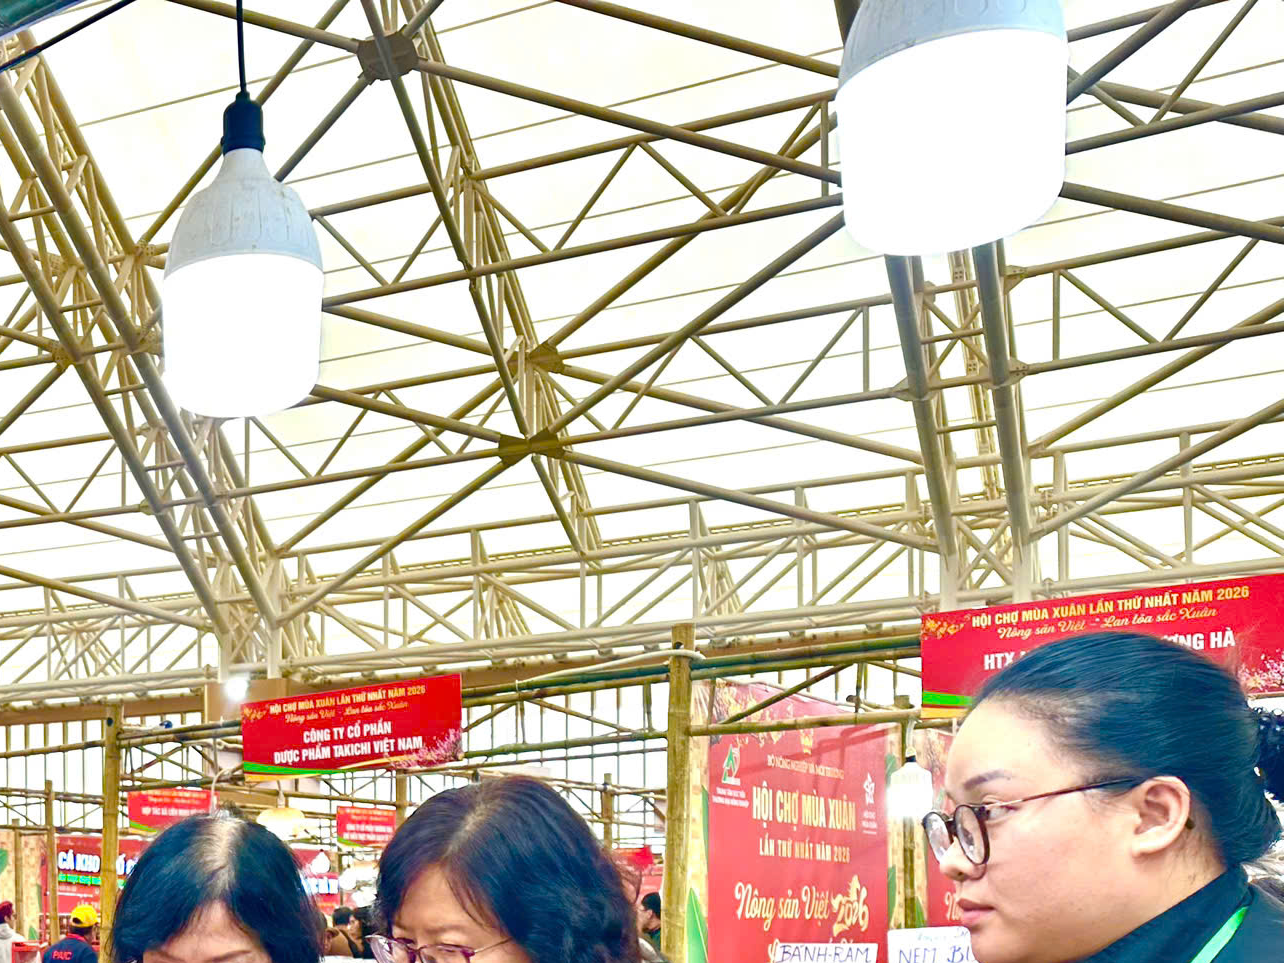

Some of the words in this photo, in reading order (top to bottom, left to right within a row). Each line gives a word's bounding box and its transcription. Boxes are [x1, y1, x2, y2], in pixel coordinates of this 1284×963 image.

[972, 613, 991, 628] HỘI
[995, 610, 1019, 626] CHỢ
[1021, 607, 1049, 622] MÙA
[1052, 603, 1086, 618] XUÂN
[1089, 598, 1114, 614] LẦN
[1117, 595, 1143, 612] THỨ
[1144, 590, 1179, 608] NHẤT
[1182, 588, 1213, 604] NĂM
[1216, 585, 1250, 600] 2026
[998, 627, 1032, 640] Nông
[1057, 620, 1086, 633] Việt
[1100, 615, 1129, 628] Lan
[1179, 606, 1217, 620] Xuân
[983, 651, 1015, 671] HTX
[1210, 626, 1236, 649] HÀ
[407, 685, 426, 696] 2026
[303, 728, 331, 743] CÔNG
[333, 727, 345, 740] TY
[347, 719, 361, 739] CỔ
[363, 717, 392, 737] PHẦN
[274, 749, 300, 765] DƯỢC
[301, 742, 331, 761] PHẨM
[332, 741, 371, 758] TAKICHI
[373, 737, 395, 757] VIỆT
[398, 735, 423, 751] NAM
[752, 781, 773, 828] HỘI
[776, 789, 799, 831] CHỢ
[802, 789, 826, 828] MÙA
[828, 795, 856, 831] XUÂN
[760, 832, 775, 856] LẦN
[777, 838, 792, 858] THỨ
[794, 836, 813, 860] NHẤT
[816, 840, 832, 861] NĂM
[75, 853, 101, 873] KHO
[735, 882, 776, 931] Nông
[778, 889, 801, 920] sản
[801, 886, 829, 926] Việt
